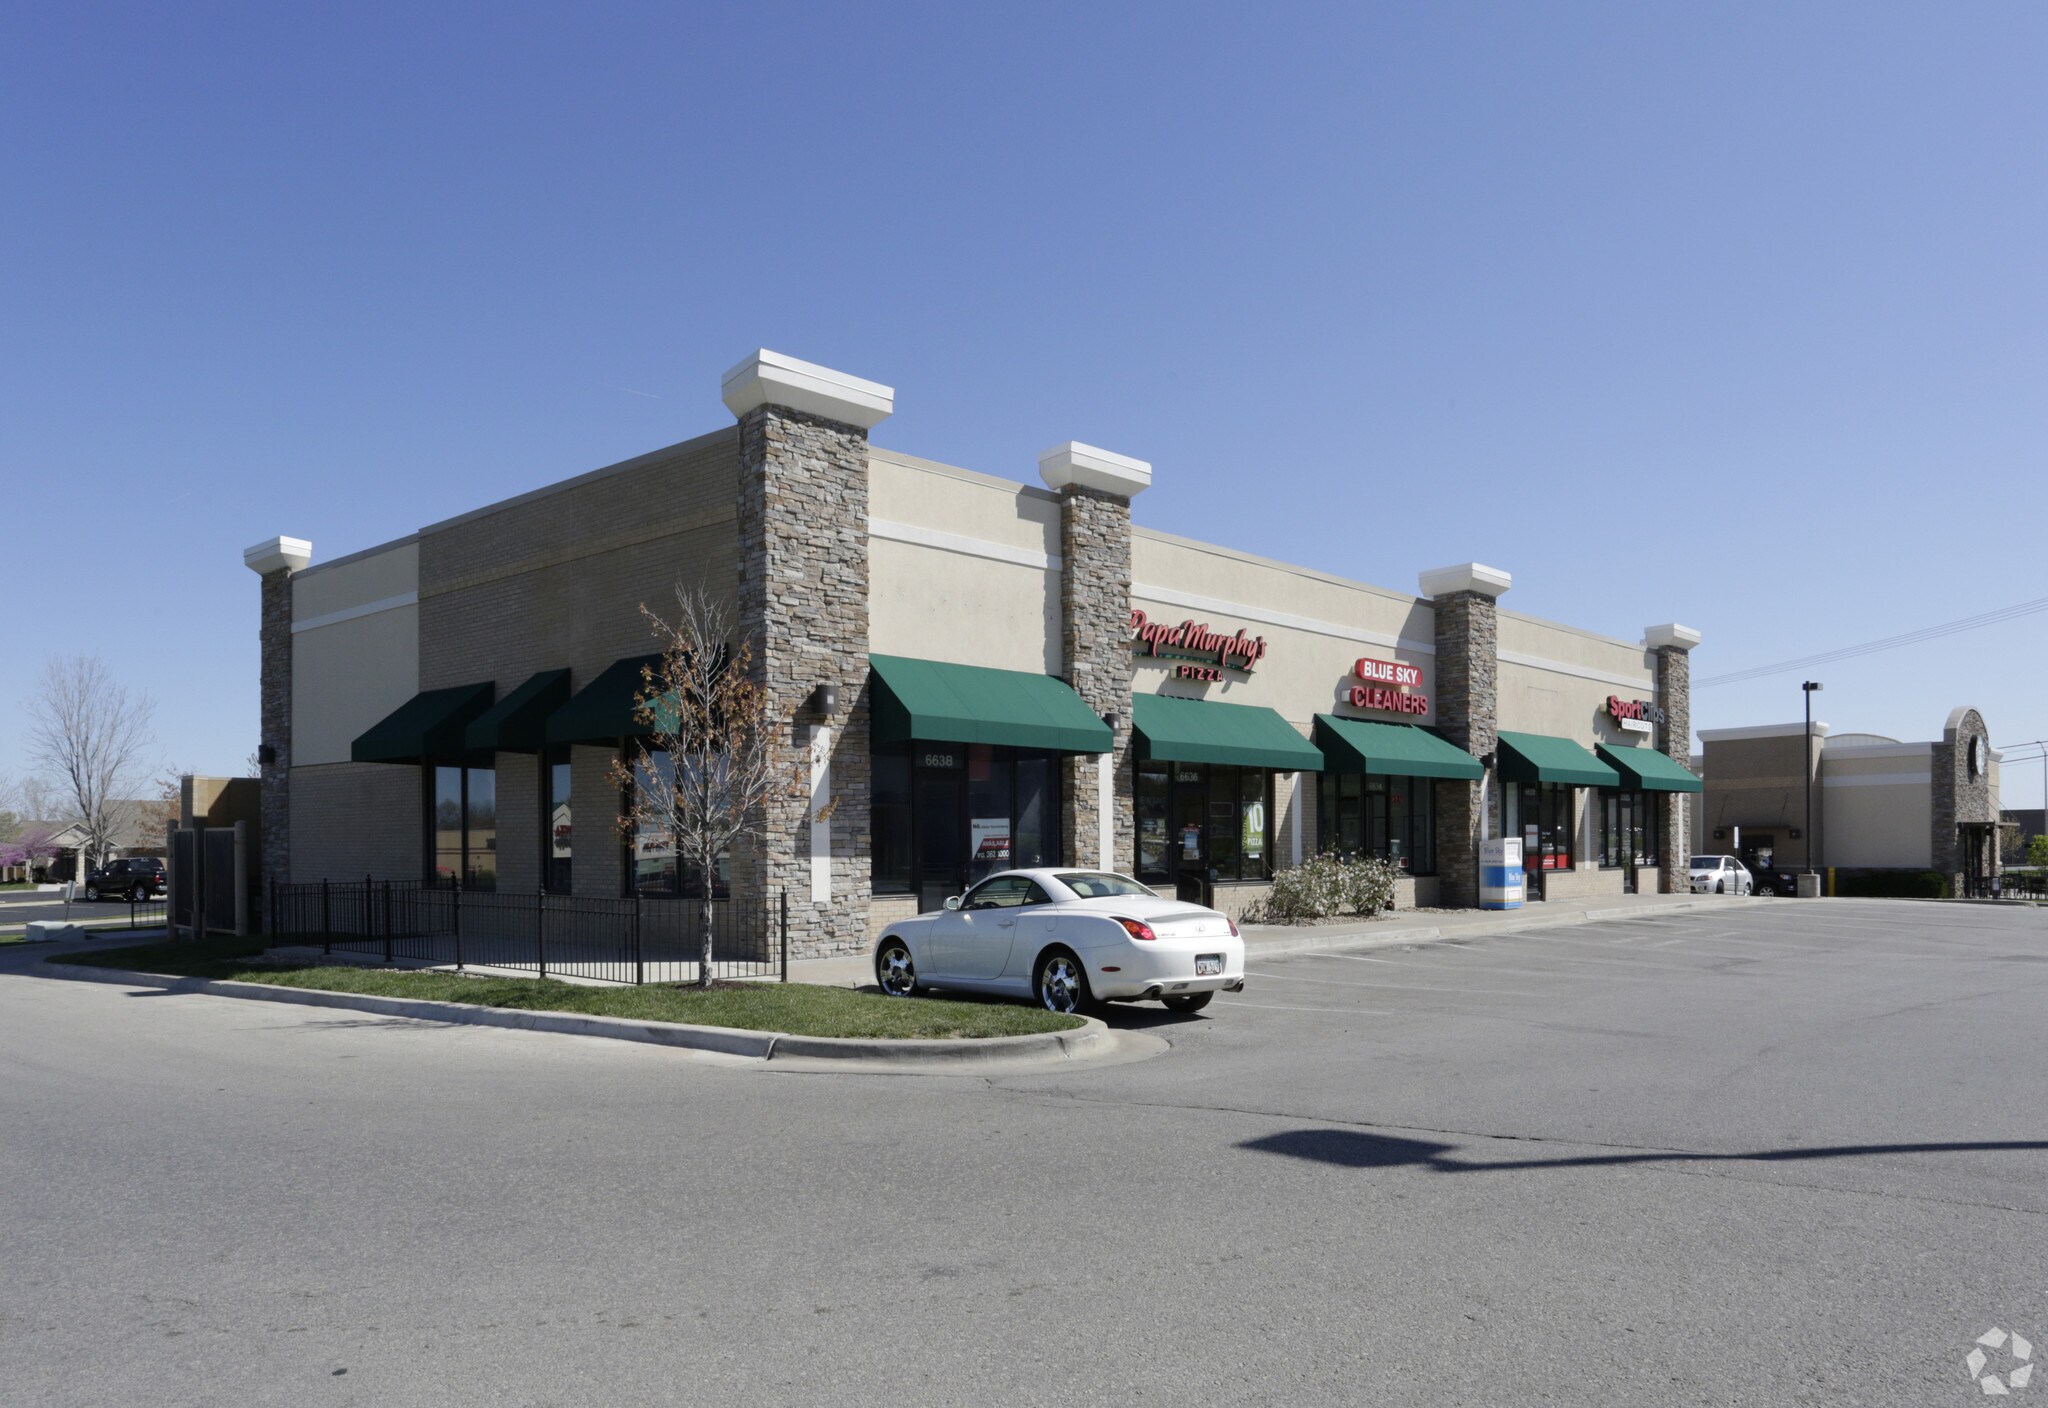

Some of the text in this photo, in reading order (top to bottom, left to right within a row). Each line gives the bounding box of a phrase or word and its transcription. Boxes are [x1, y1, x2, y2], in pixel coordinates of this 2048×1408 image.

[1181, 619, 1267, 669] Murphy's
[1181, 665, 1224, 681] PIZZA
[1364, 661, 1418, 684] BLUE SKY
[1354, 685, 1429, 716] CLEANERS
[925, 754, 953, 767] 6638
[1180, 771, 1198, 782] 6636
